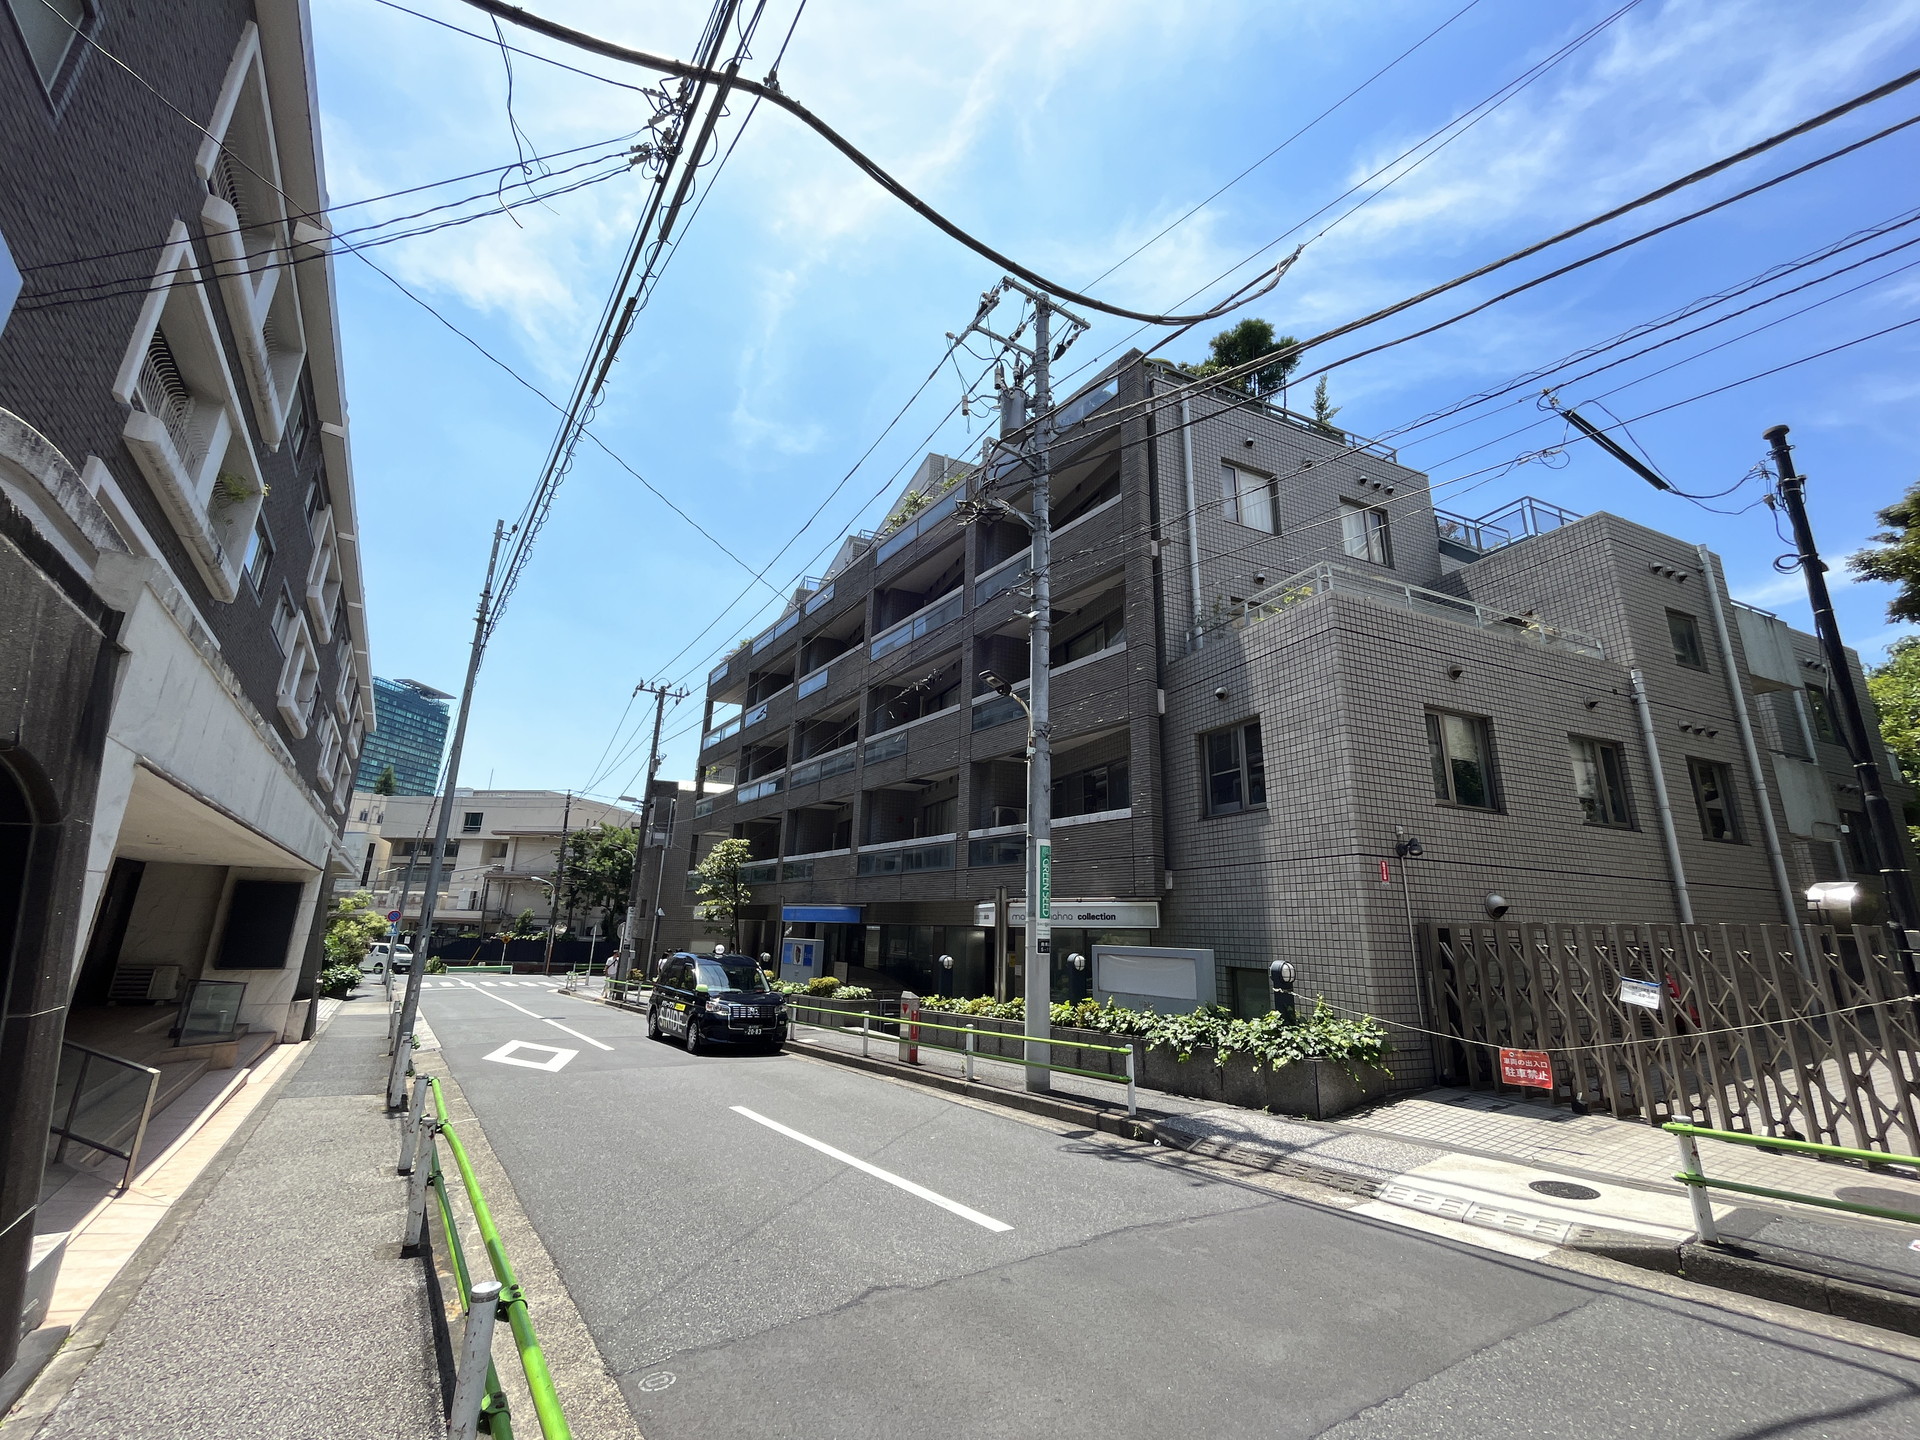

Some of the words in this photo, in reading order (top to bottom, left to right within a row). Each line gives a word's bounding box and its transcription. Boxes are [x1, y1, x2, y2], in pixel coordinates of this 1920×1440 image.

[1077, 912, 1116, 921] collection
[1503, 1058, 1548, 1068] 車両の出入口
[1504, 1067, 1549, 1081] 駐車禁止
